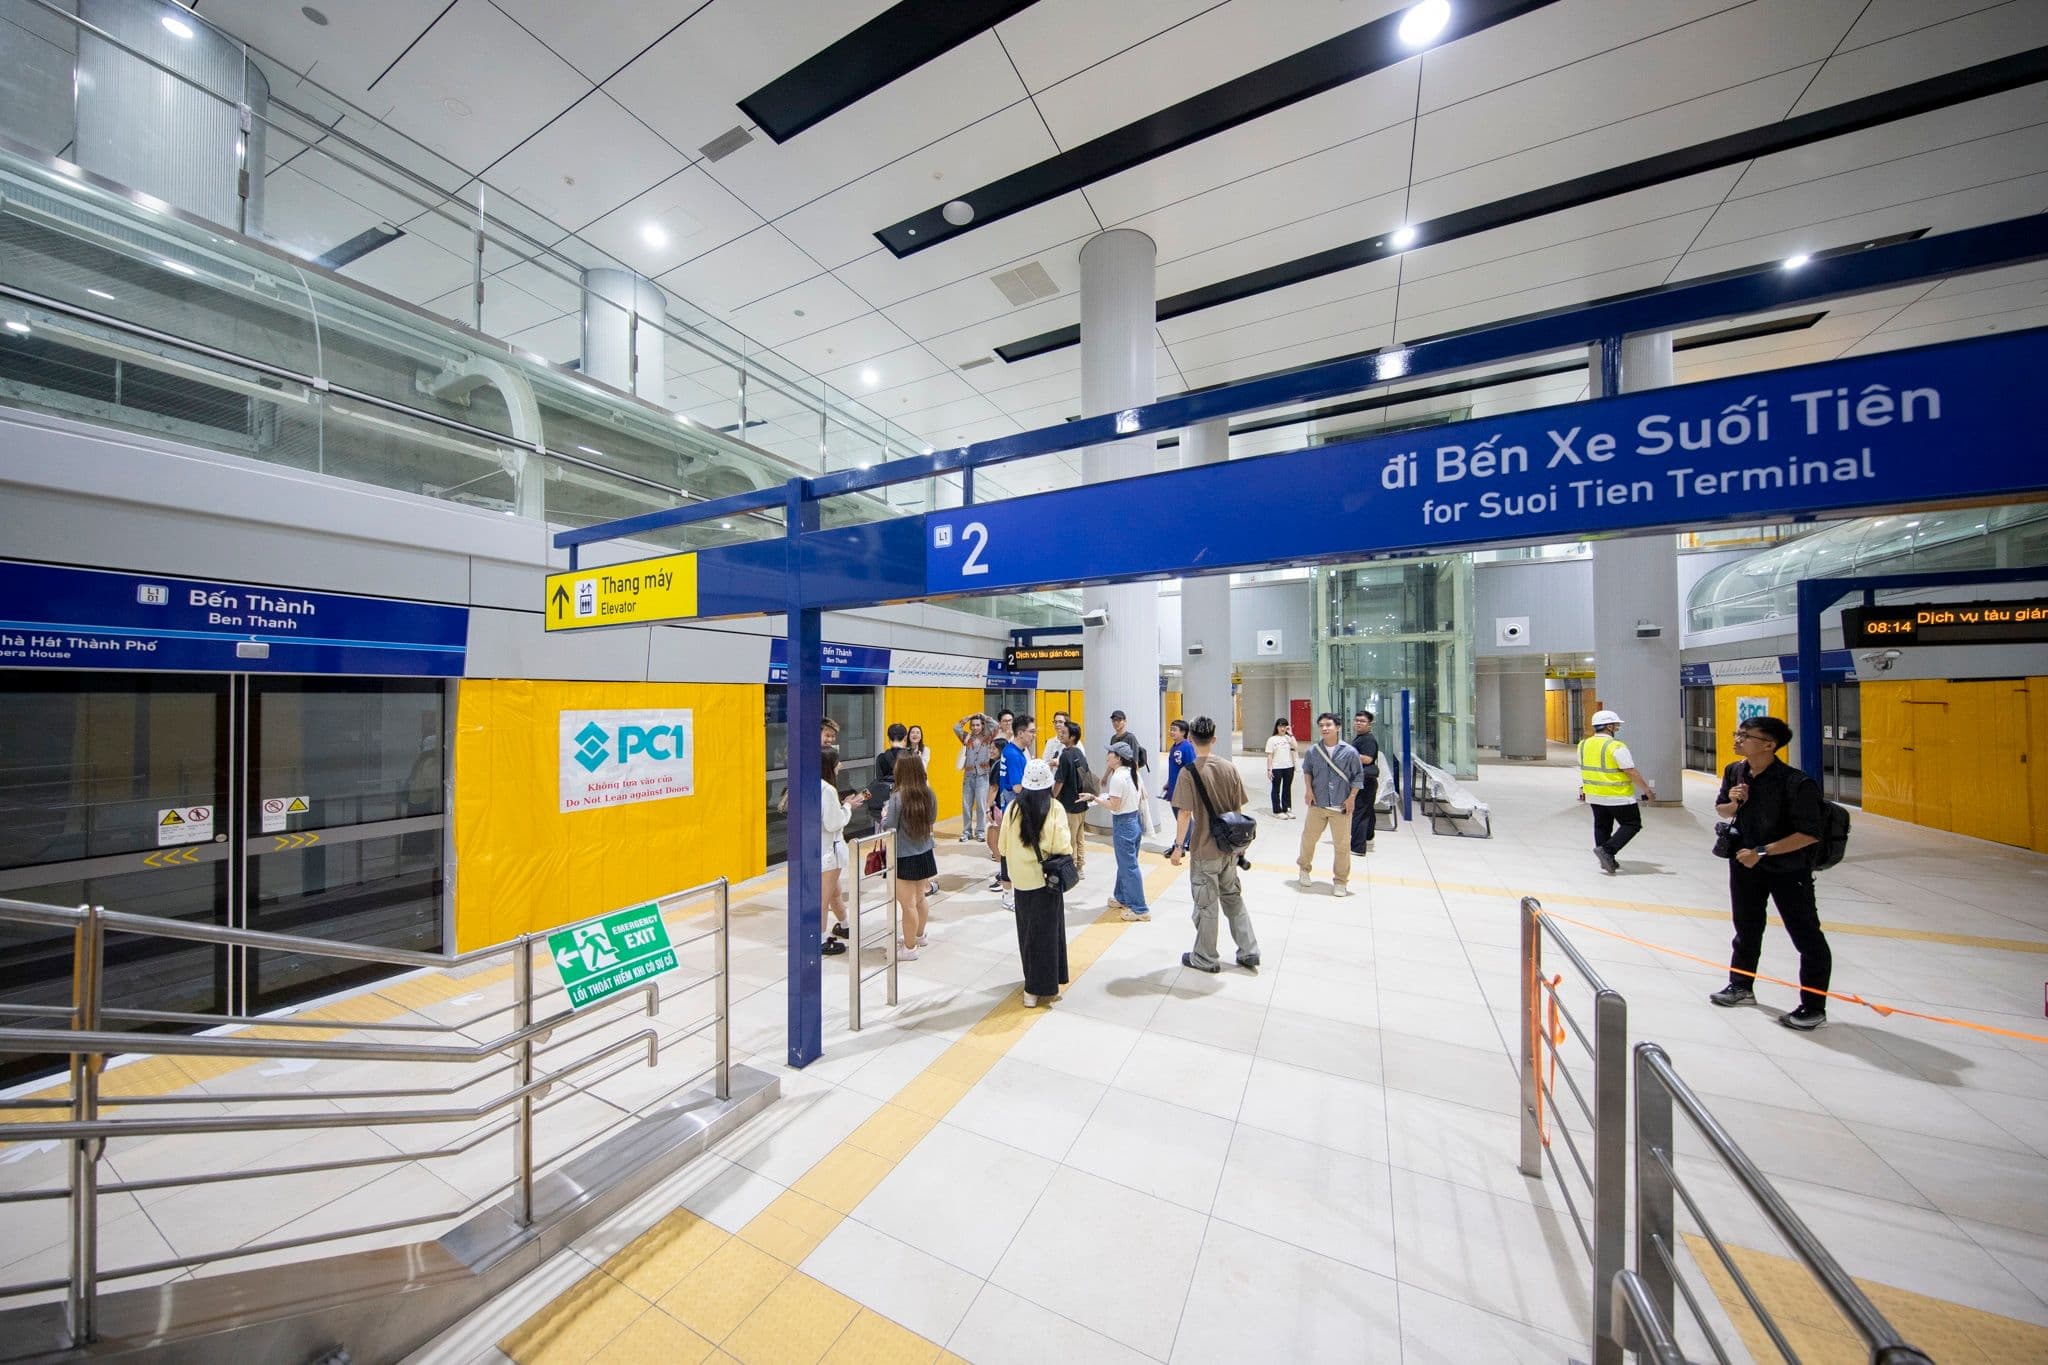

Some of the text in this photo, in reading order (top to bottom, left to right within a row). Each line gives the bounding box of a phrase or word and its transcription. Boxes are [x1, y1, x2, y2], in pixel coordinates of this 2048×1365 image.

[1381, 384, 1941, 490] đi Bến Xe Suối Tiên
[1422, 447, 1876, 525] for Suoi Tien Terminal
[939, 532, 948, 541] L1
[961, 522, 989, 576] 2
[602, 568, 673, 595] Thang máy
[189, 589, 316, 615] Bến Thành
[601, 601, 637, 615] Elevator
[208, 612, 297, 629] Ben Thanh
[1917, 610, 1954, 625] Dịch
[1960, 612, 1979, 623] vụ
[1985, 609, 2010, 621] tàu
[1867, 620, 1912, 634] 08:14
[0, 634, 158, 651] hà Hát Thành Phố
[30, 649, 71, 659] House
[1008, 655, 1015, 666] 2
[618, 725, 684, 764] PC1
[566, 785, 690, 808] Do Not Lean against Doors
[611, 914, 658, 935] EMERGENCY
[624, 927, 656, 949] EXIT
[632, 965, 647, 979] KHI
